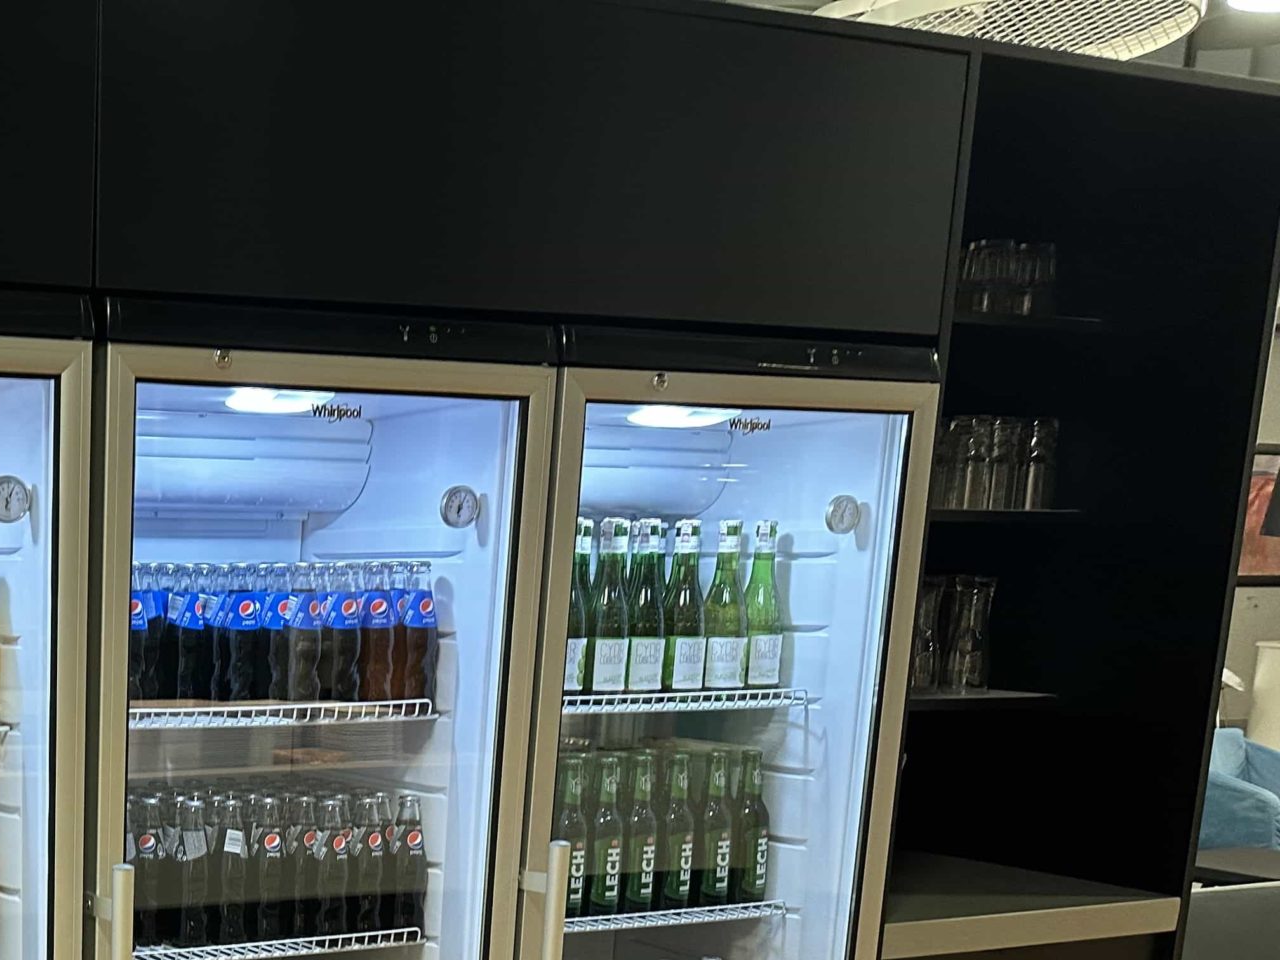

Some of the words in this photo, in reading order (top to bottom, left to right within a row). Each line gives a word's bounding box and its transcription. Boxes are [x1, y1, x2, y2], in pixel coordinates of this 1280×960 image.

[312, 403, 362, 421] Whirlpool
[729, 418, 771, 434] Whirlpool
[571, 850, 584, 899] LECH
[605, 848, 620, 897] LECH
[640, 846, 654, 894] LECH
[679, 843, 692, 892] LECH
[716, 840, 730, 888] LECH
[756, 838, 768, 886] LECH
